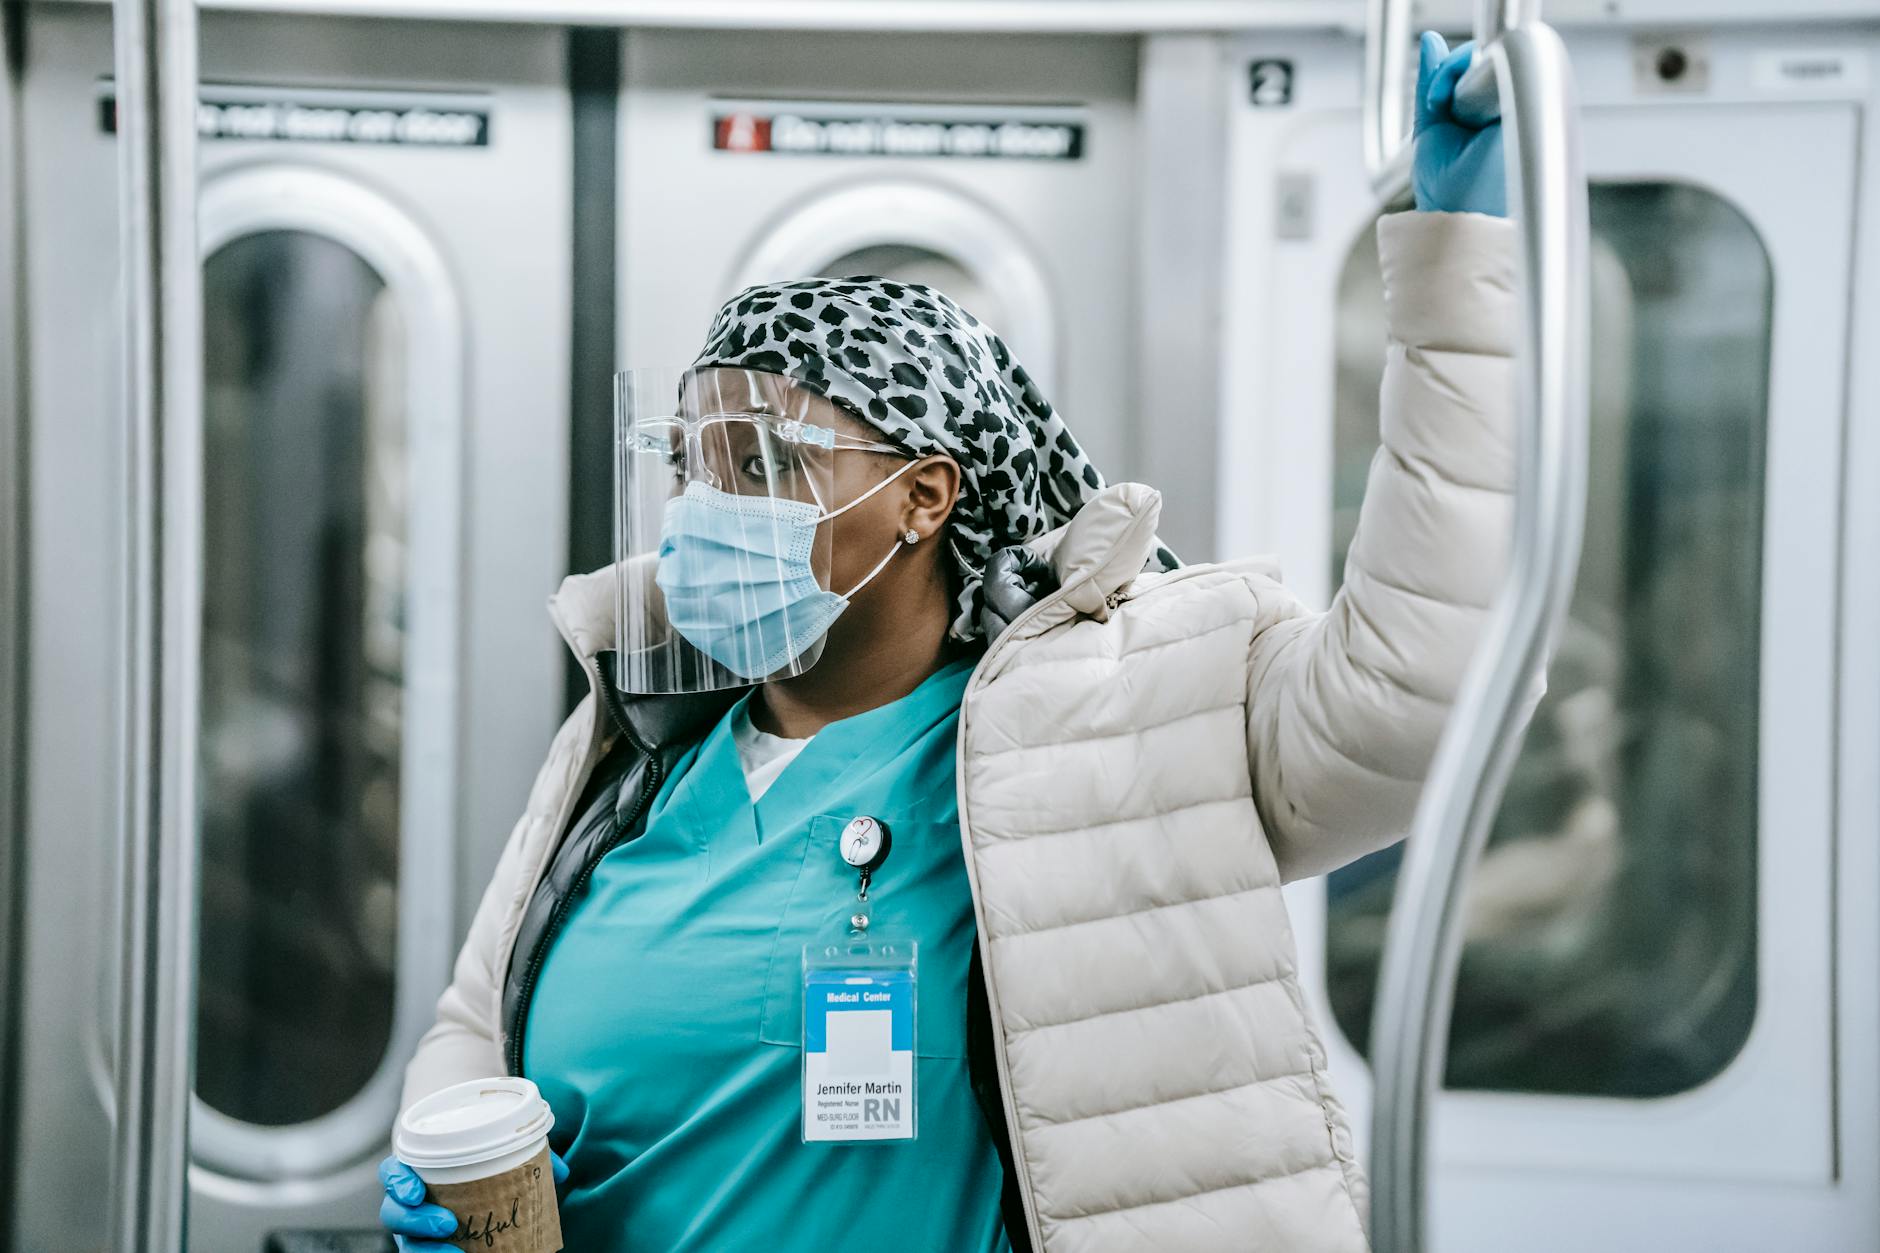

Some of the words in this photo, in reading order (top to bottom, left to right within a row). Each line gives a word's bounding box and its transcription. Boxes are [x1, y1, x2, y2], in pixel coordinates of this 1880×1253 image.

[1254, 63, 1286, 104] 2
[224, 103, 275, 135] not
[279, 103, 349, 138] lean
[351, 110, 395, 139] on
[400, 108, 480, 142] door
[772, 114, 821, 149] Do
[826, 116, 874, 151] not
[879, 117, 946, 152] lean
[949, 124, 991, 153] on
[996, 121, 1071, 154] door
[826, 991, 859, 1003] Medical
[863, 991, 891, 1002] Center
[817, 1082, 861, 1095] Jennifer
[865, 1081, 902, 1094] Martin
[817, 1100, 843, 1108] Registered
[864, 1098, 900, 1122] RN
